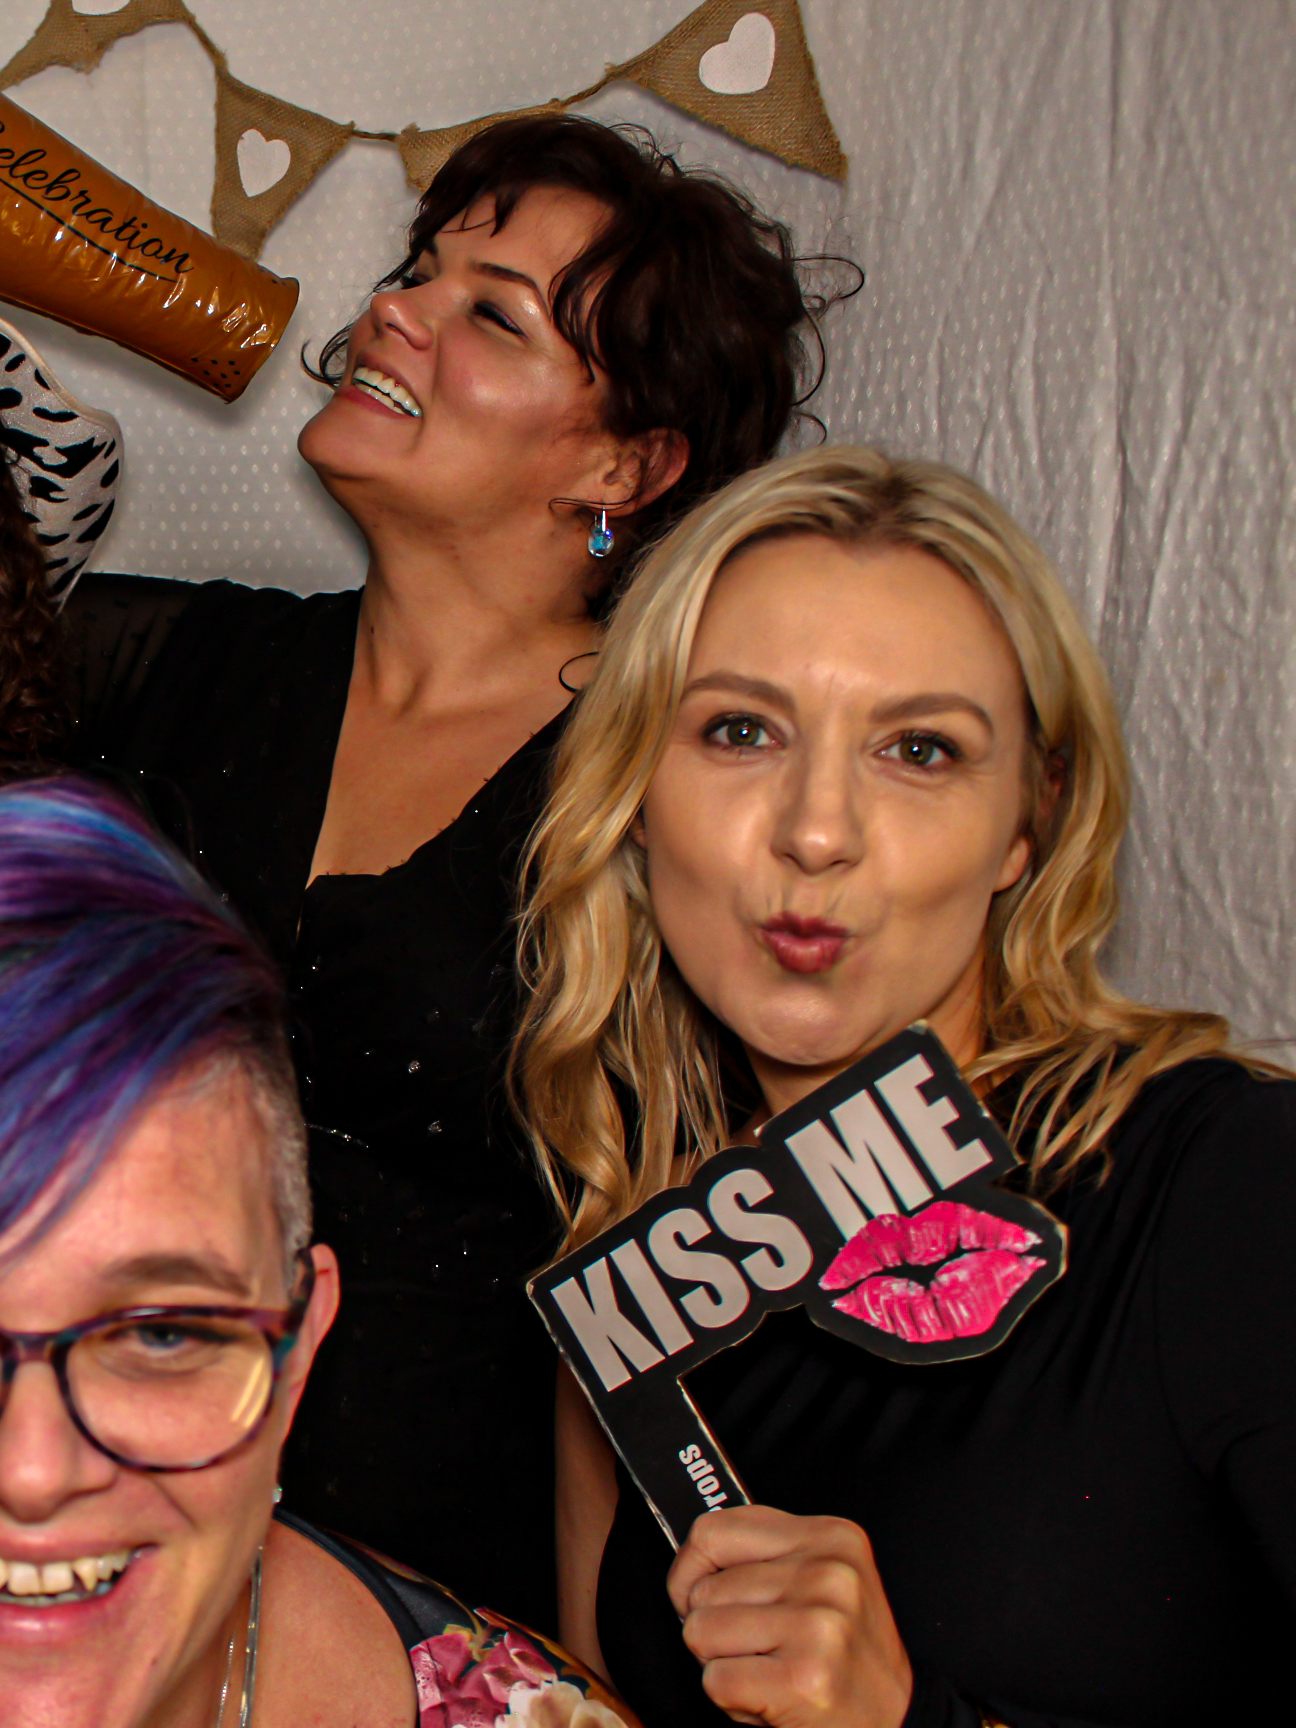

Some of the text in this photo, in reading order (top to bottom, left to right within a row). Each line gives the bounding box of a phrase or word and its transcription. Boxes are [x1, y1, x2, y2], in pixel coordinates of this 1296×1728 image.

[550, 1053, 993, 1392] KISS ME
[678, 1443, 728, 1512] rops
